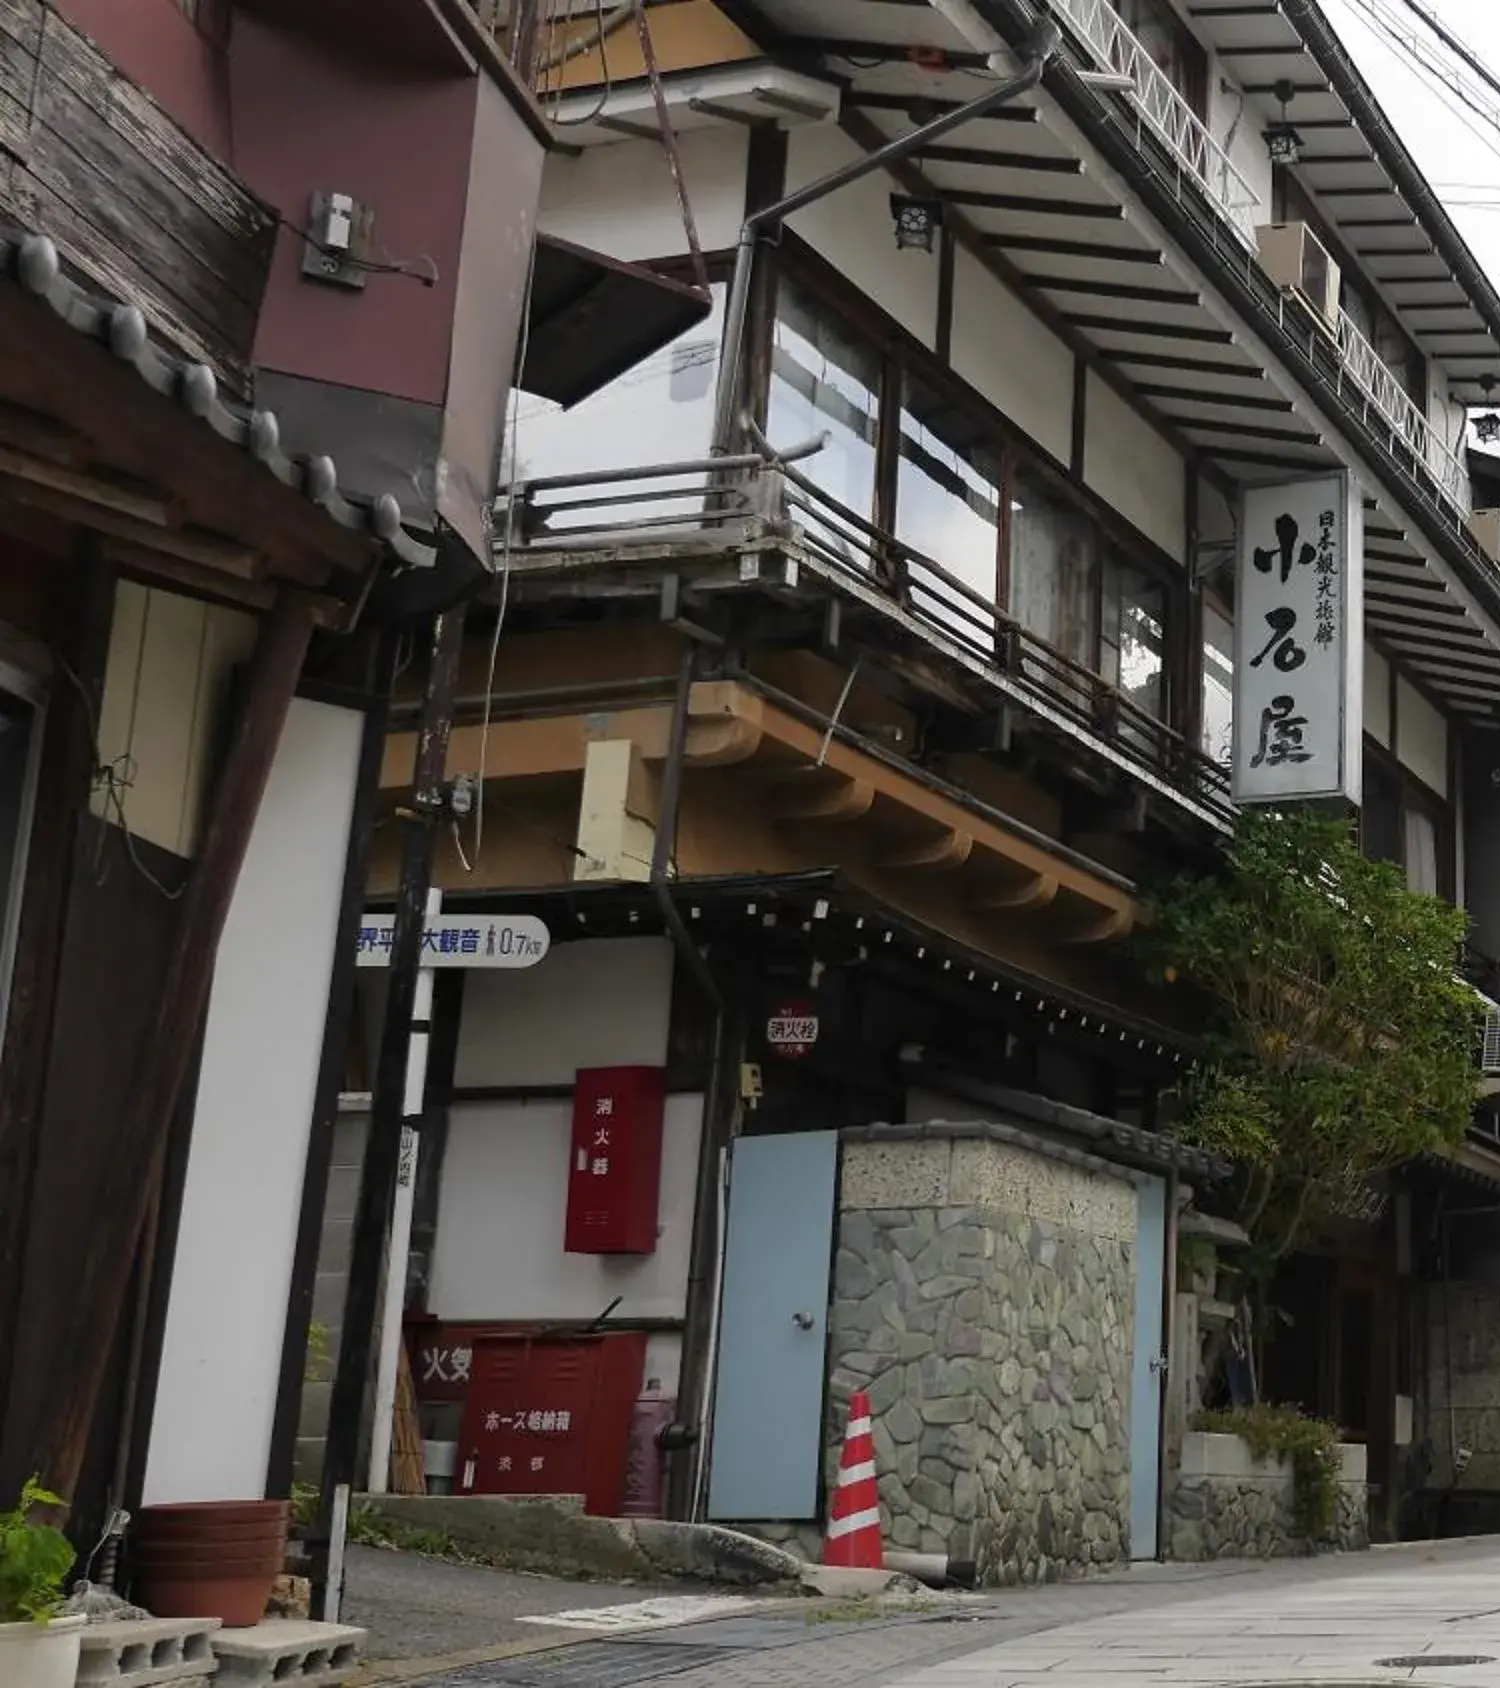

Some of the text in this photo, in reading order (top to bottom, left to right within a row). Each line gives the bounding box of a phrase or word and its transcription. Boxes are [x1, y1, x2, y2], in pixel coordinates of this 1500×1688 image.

[1250, 513, 1318, 770] 小石屋
[770, 1020, 816, 1040] 消火栓
[592, 1097, 614, 1176] 消火器
[484, 1409, 572, 1433] ホース格納箱
